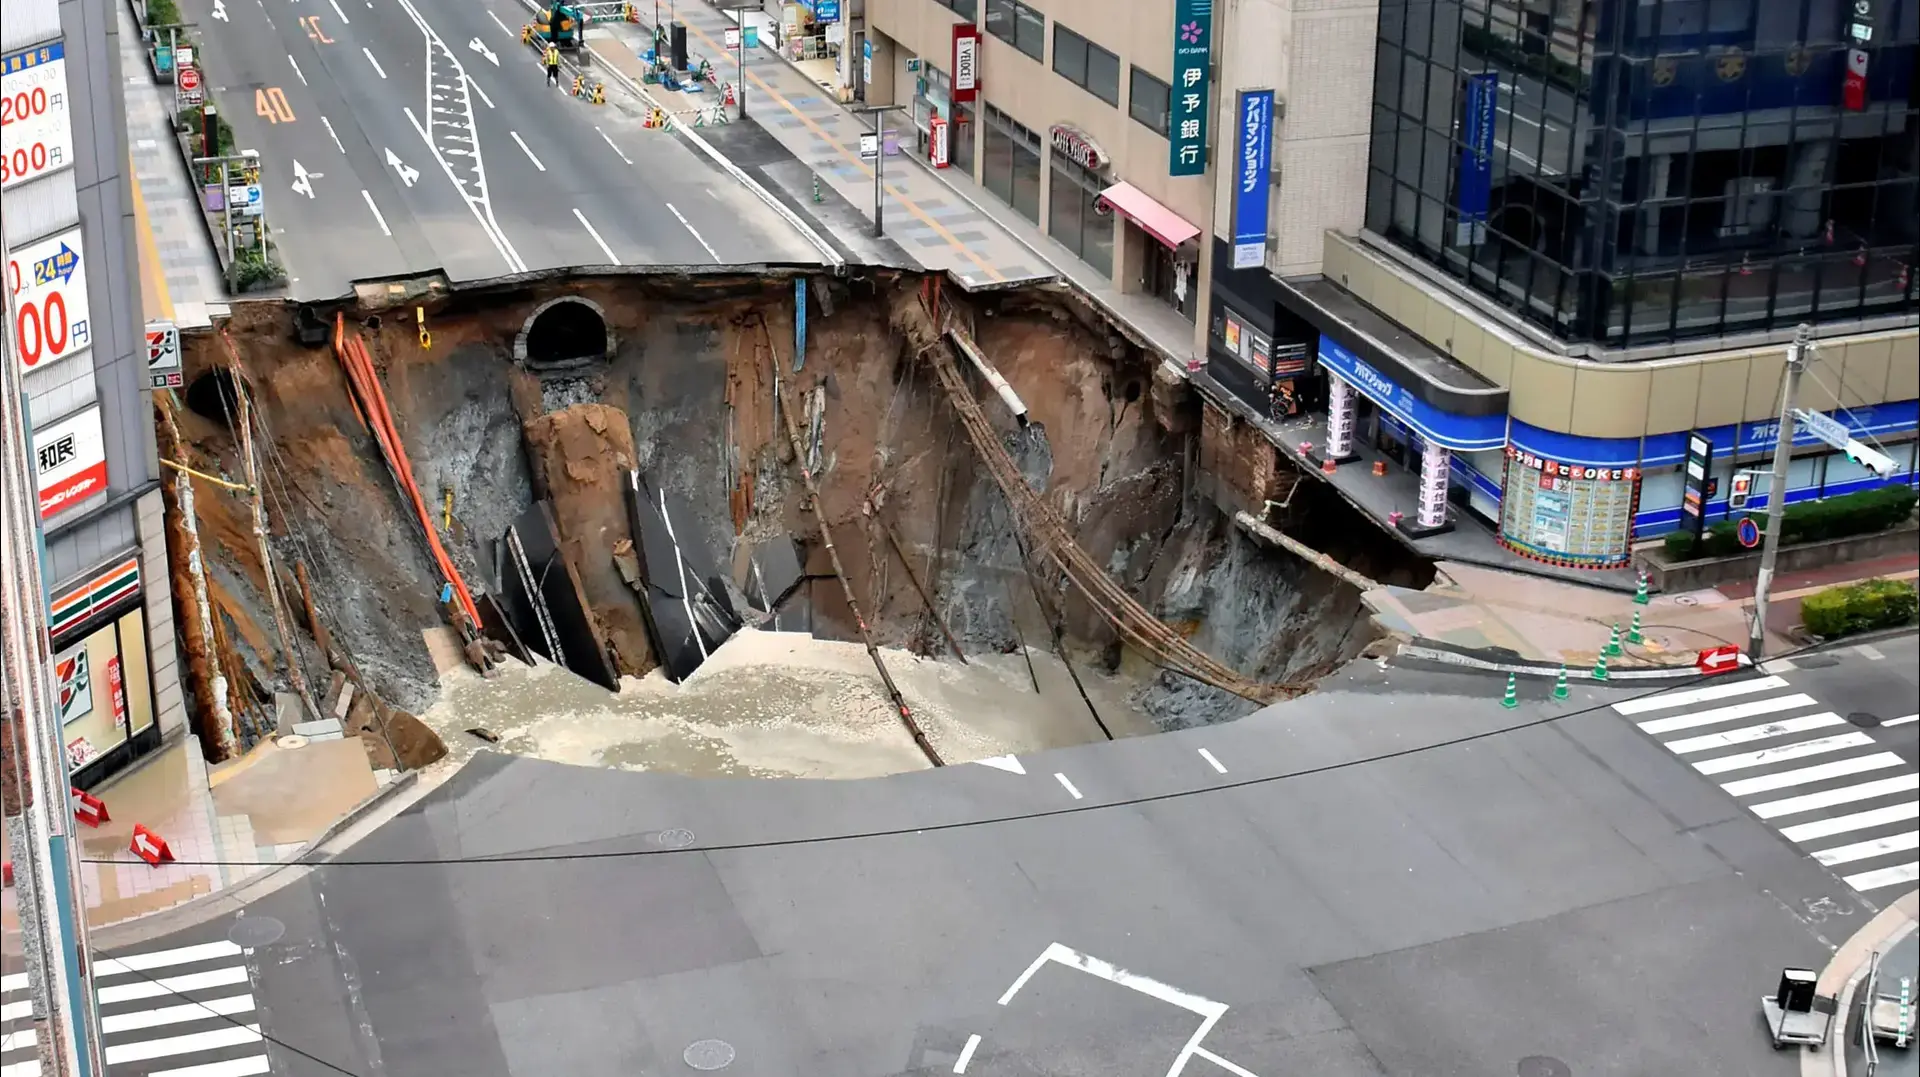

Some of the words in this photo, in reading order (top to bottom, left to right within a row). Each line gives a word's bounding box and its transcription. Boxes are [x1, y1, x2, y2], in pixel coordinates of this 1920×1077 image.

[256, 87, 296, 124] 40
[1180, 68, 1202, 165] 伊予銀行
[39, 436, 74, 470] 和民
